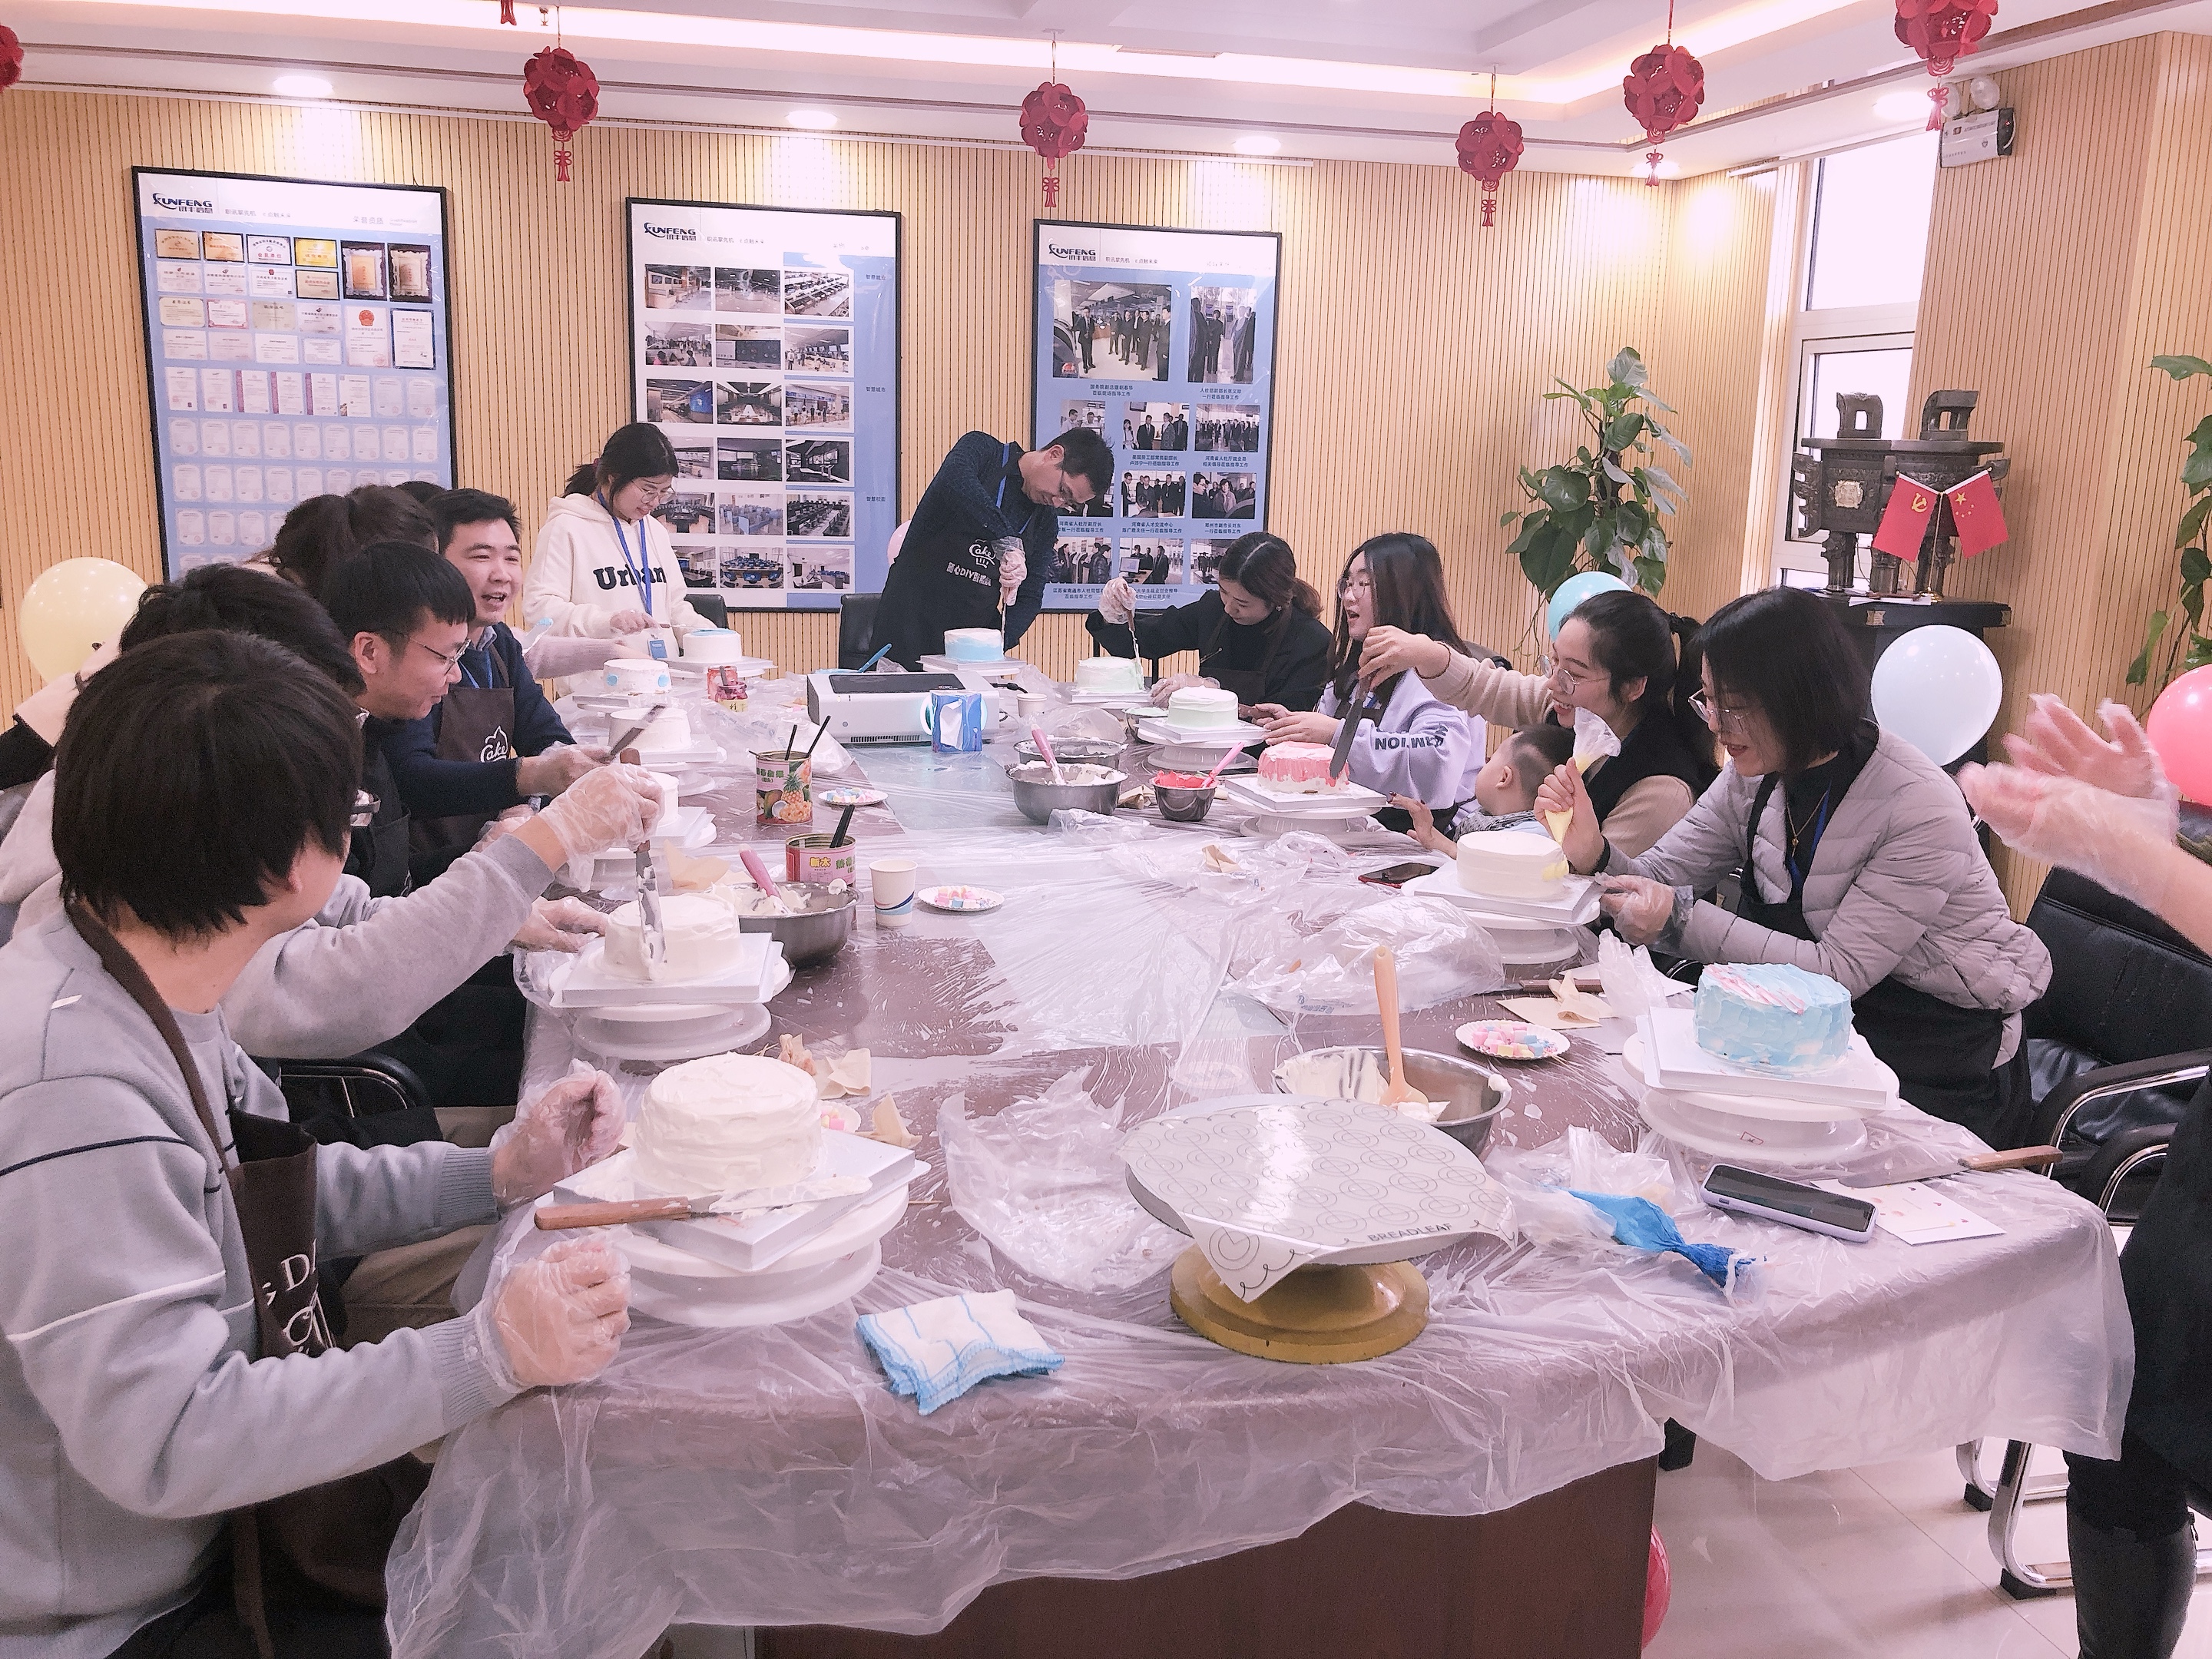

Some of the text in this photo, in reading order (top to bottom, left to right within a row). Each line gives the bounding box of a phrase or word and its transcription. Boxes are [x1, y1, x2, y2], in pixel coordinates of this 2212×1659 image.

[153, 193, 213, 209] XUNFENG
[644, 222, 696, 238] XUNFENG
[1048, 243, 1096, 259] XUNFENG
[593, 564, 667, 590] Urban
[1367, 1223, 1453, 1242] BREADLEAF
